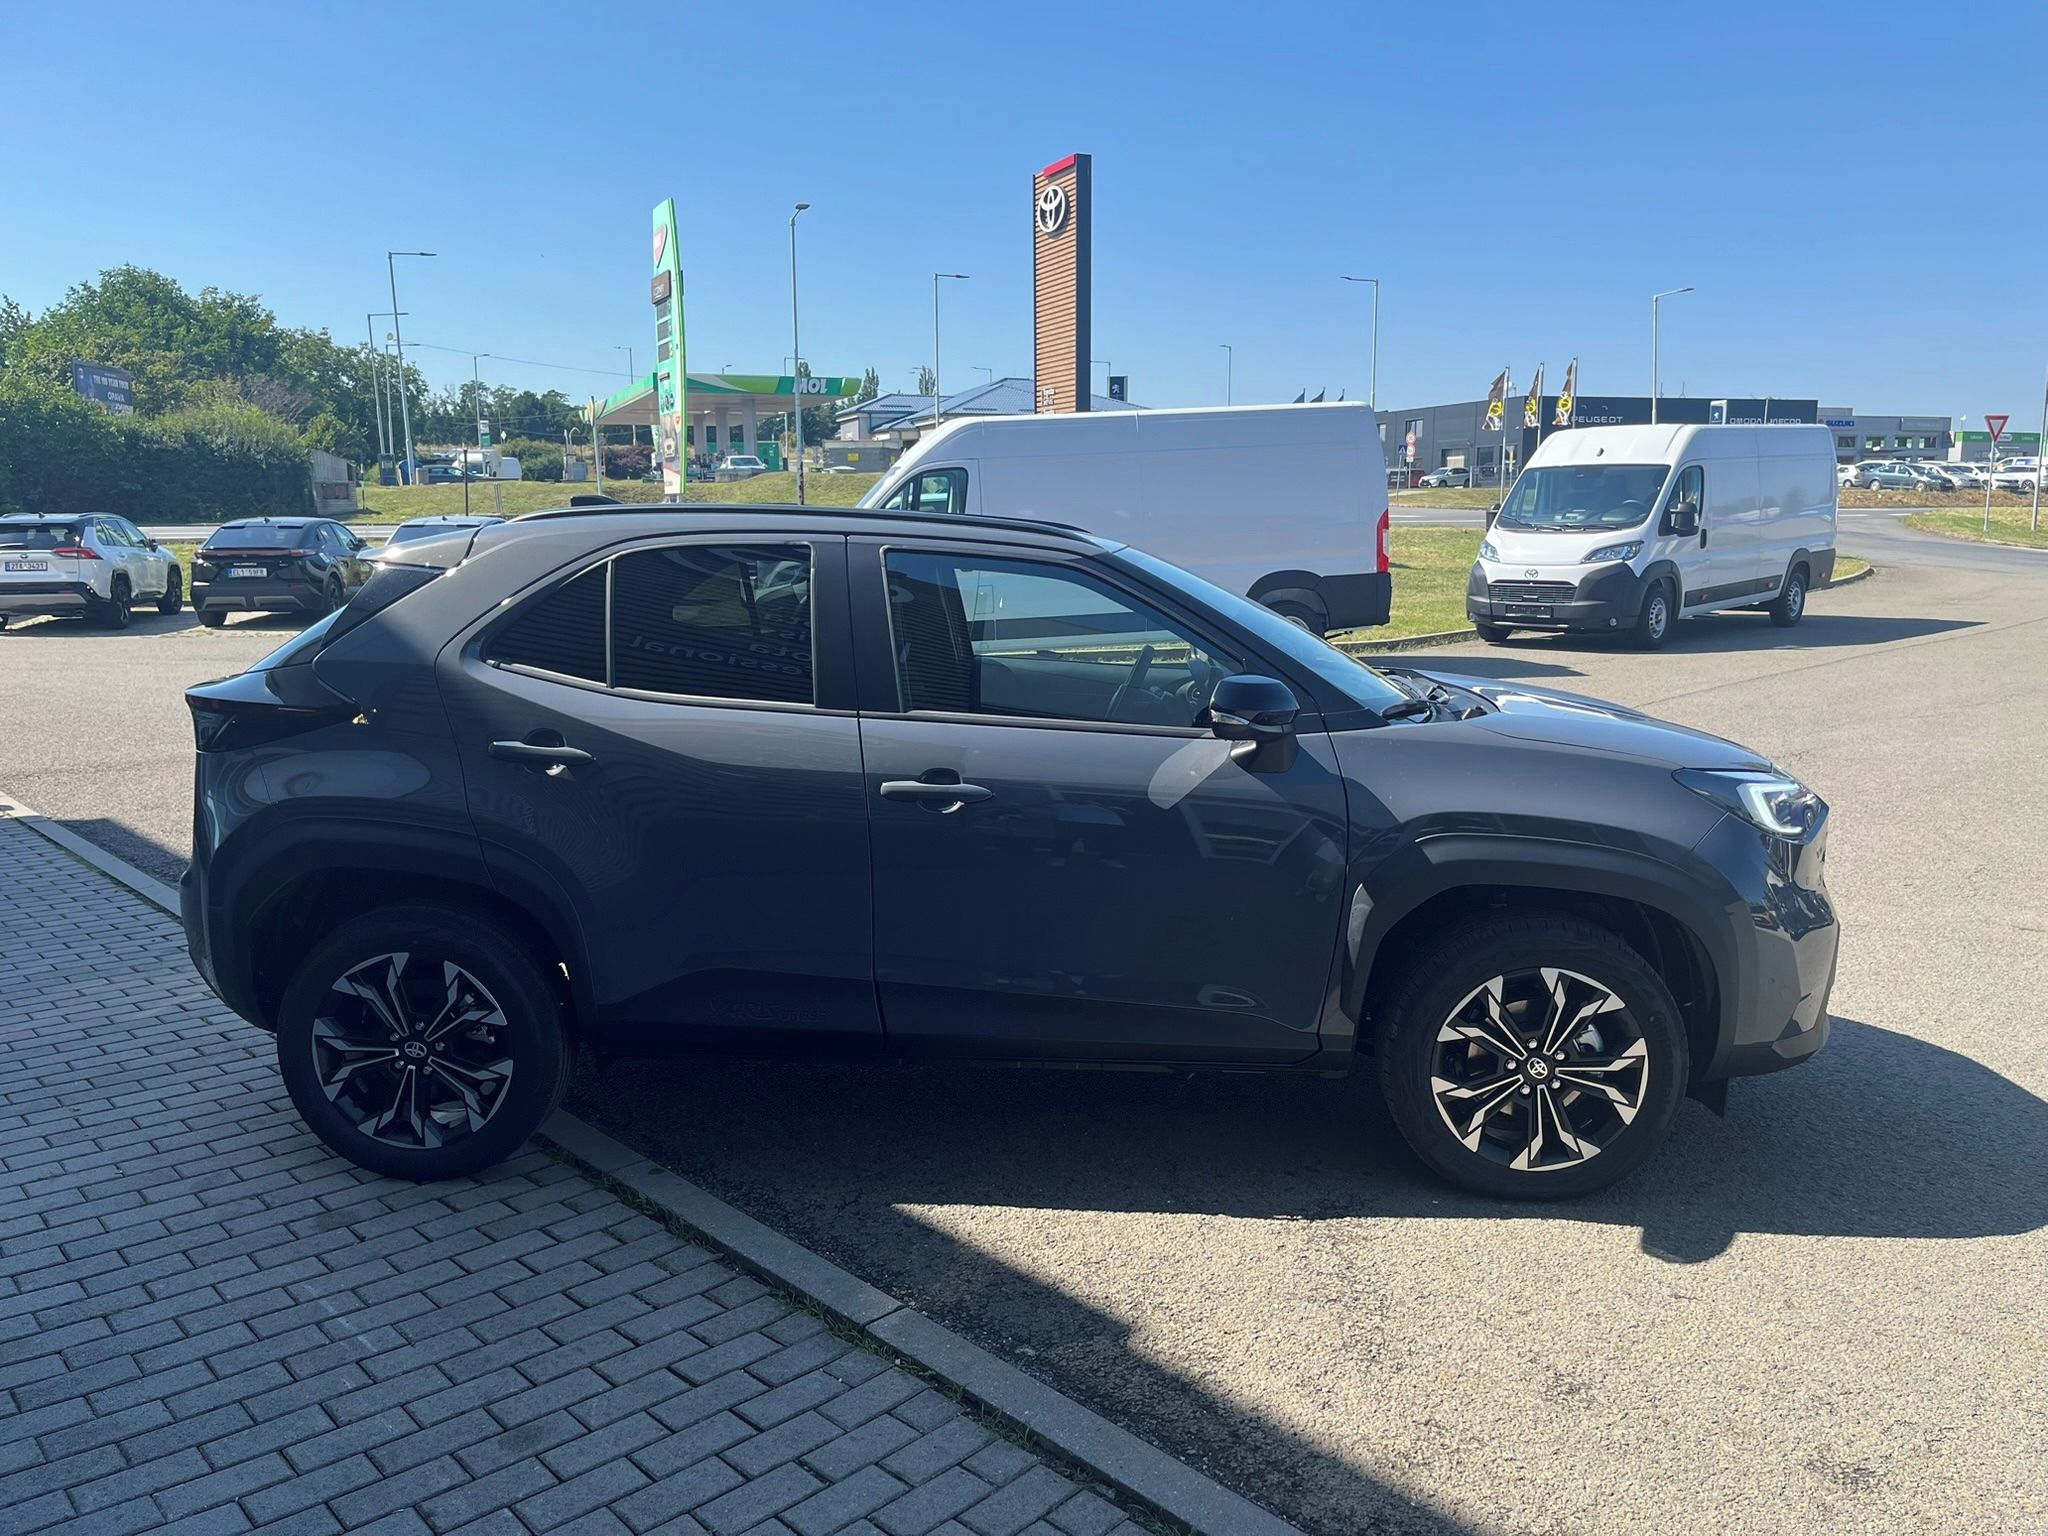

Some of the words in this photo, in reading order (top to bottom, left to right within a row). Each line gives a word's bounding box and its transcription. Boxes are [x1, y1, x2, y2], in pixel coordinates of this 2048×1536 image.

[792, 378, 828, 394] MOL
[107, 391, 125, 402] OPAVA
[1570, 415, 1623, 424] PEUGEOT
[1729, 417, 1763, 425] OMODA
[1825, 419, 1855, 427] SUZUKI
